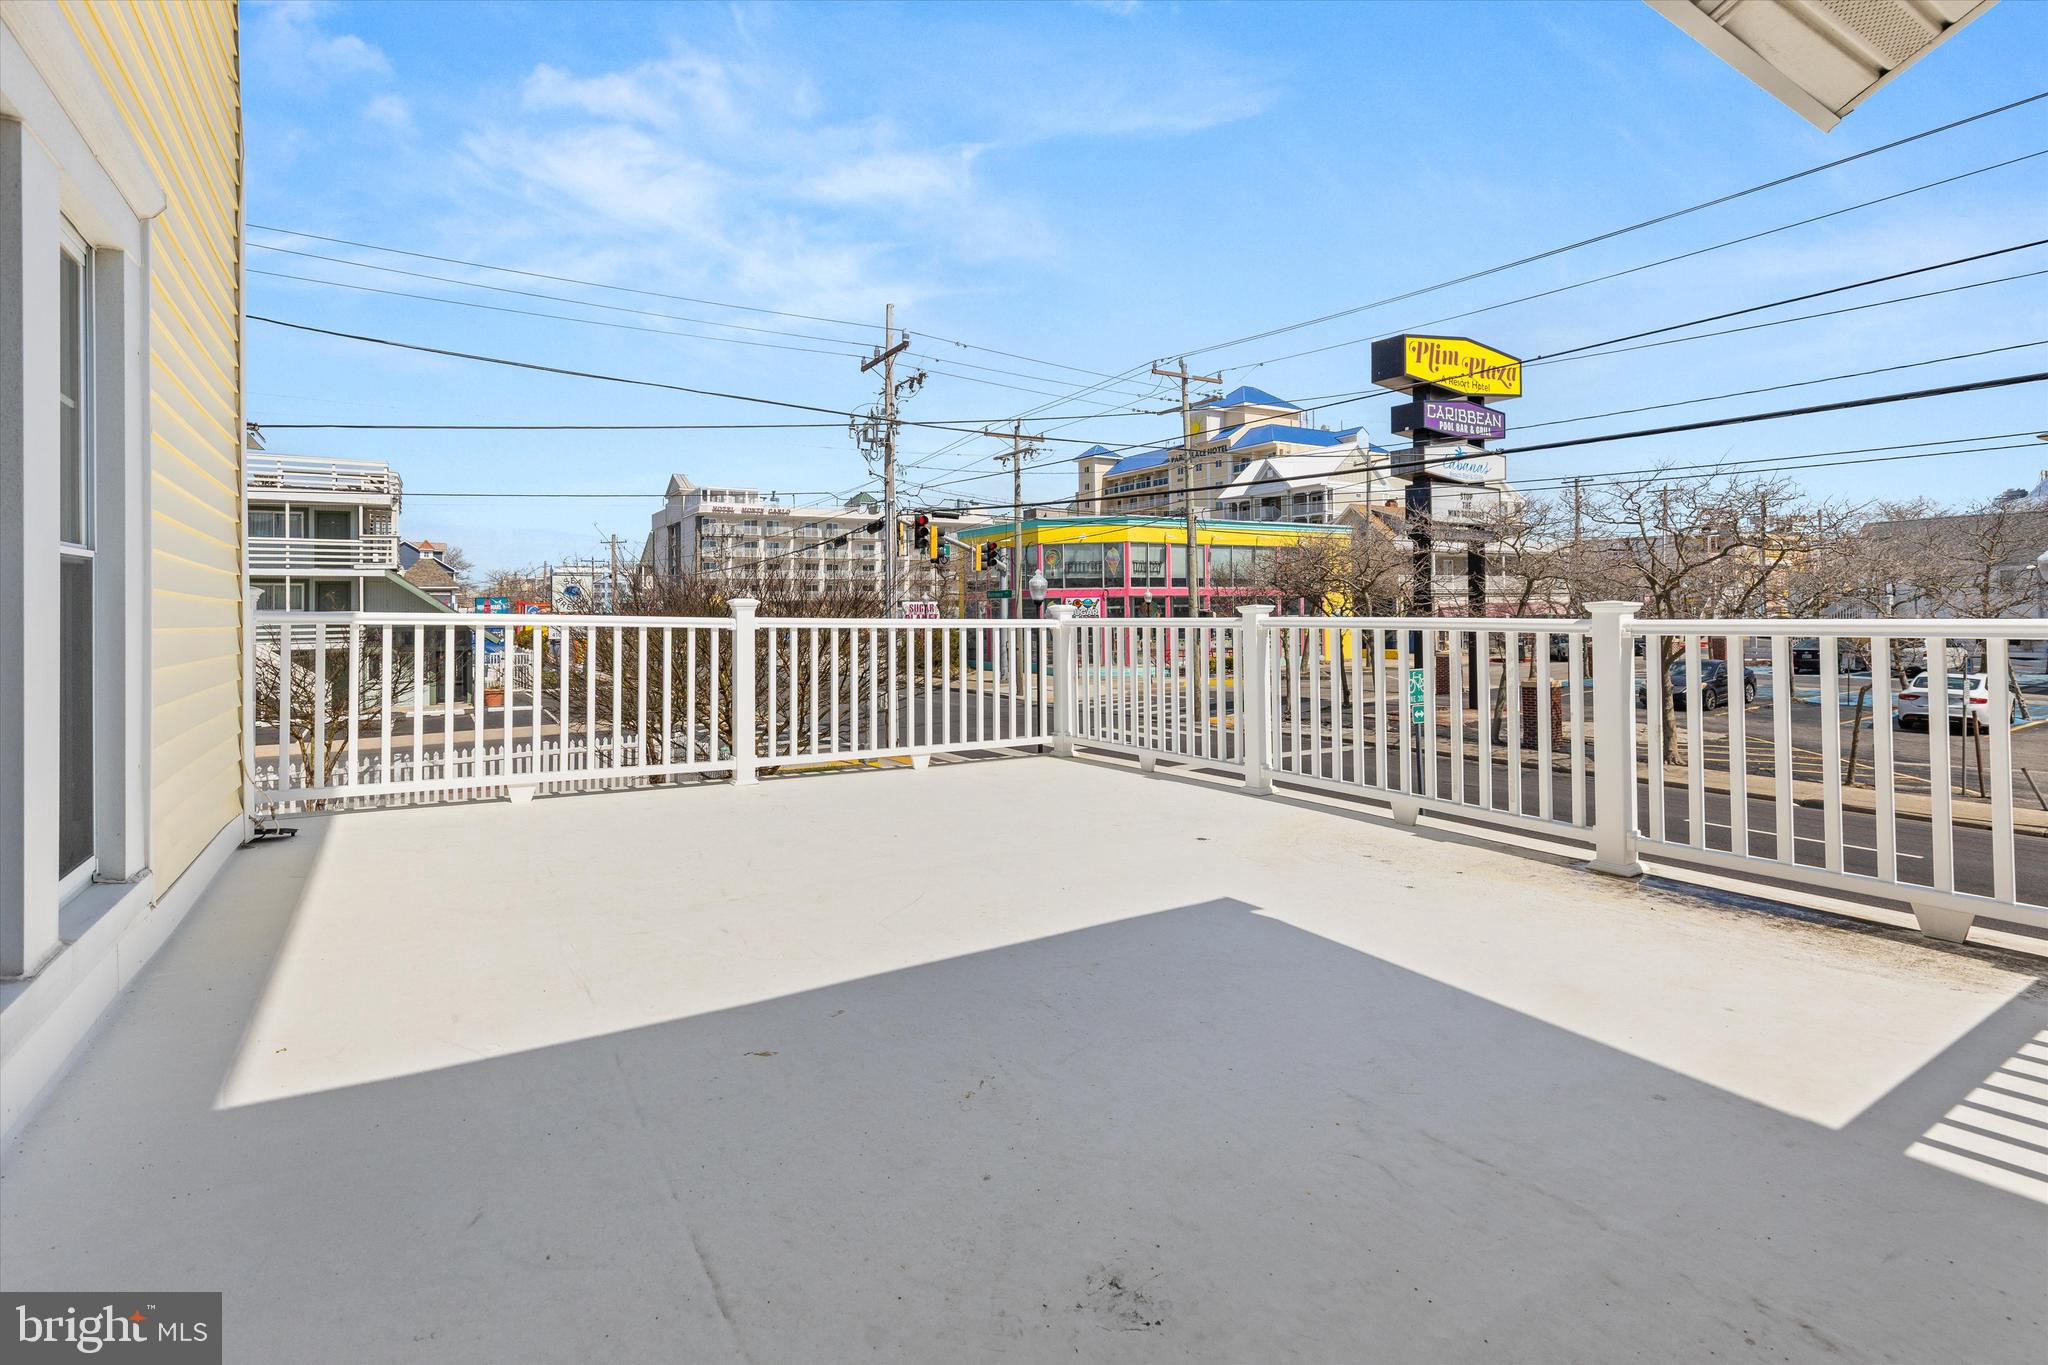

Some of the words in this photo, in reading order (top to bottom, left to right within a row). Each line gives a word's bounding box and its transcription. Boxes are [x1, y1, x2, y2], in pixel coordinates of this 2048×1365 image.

[1409, 341, 1459, 373] Plim
[1462, 357, 1517, 389] Plaza
[1448, 377, 1470, 388] Resort
[1472, 381, 1491, 392] Hotel
[1427, 404, 1502, 428] CARIBBEAN
[1439, 420, 1454, 432] POOL
[1456, 422, 1468, 434] BAR
[1470, 425, 1475, 435] &
[1476, 426, 1492, 437] GRILL
[1208, 444, 1228, 455] HOTEL
[1074, 608, 1099, 616] UGAR
